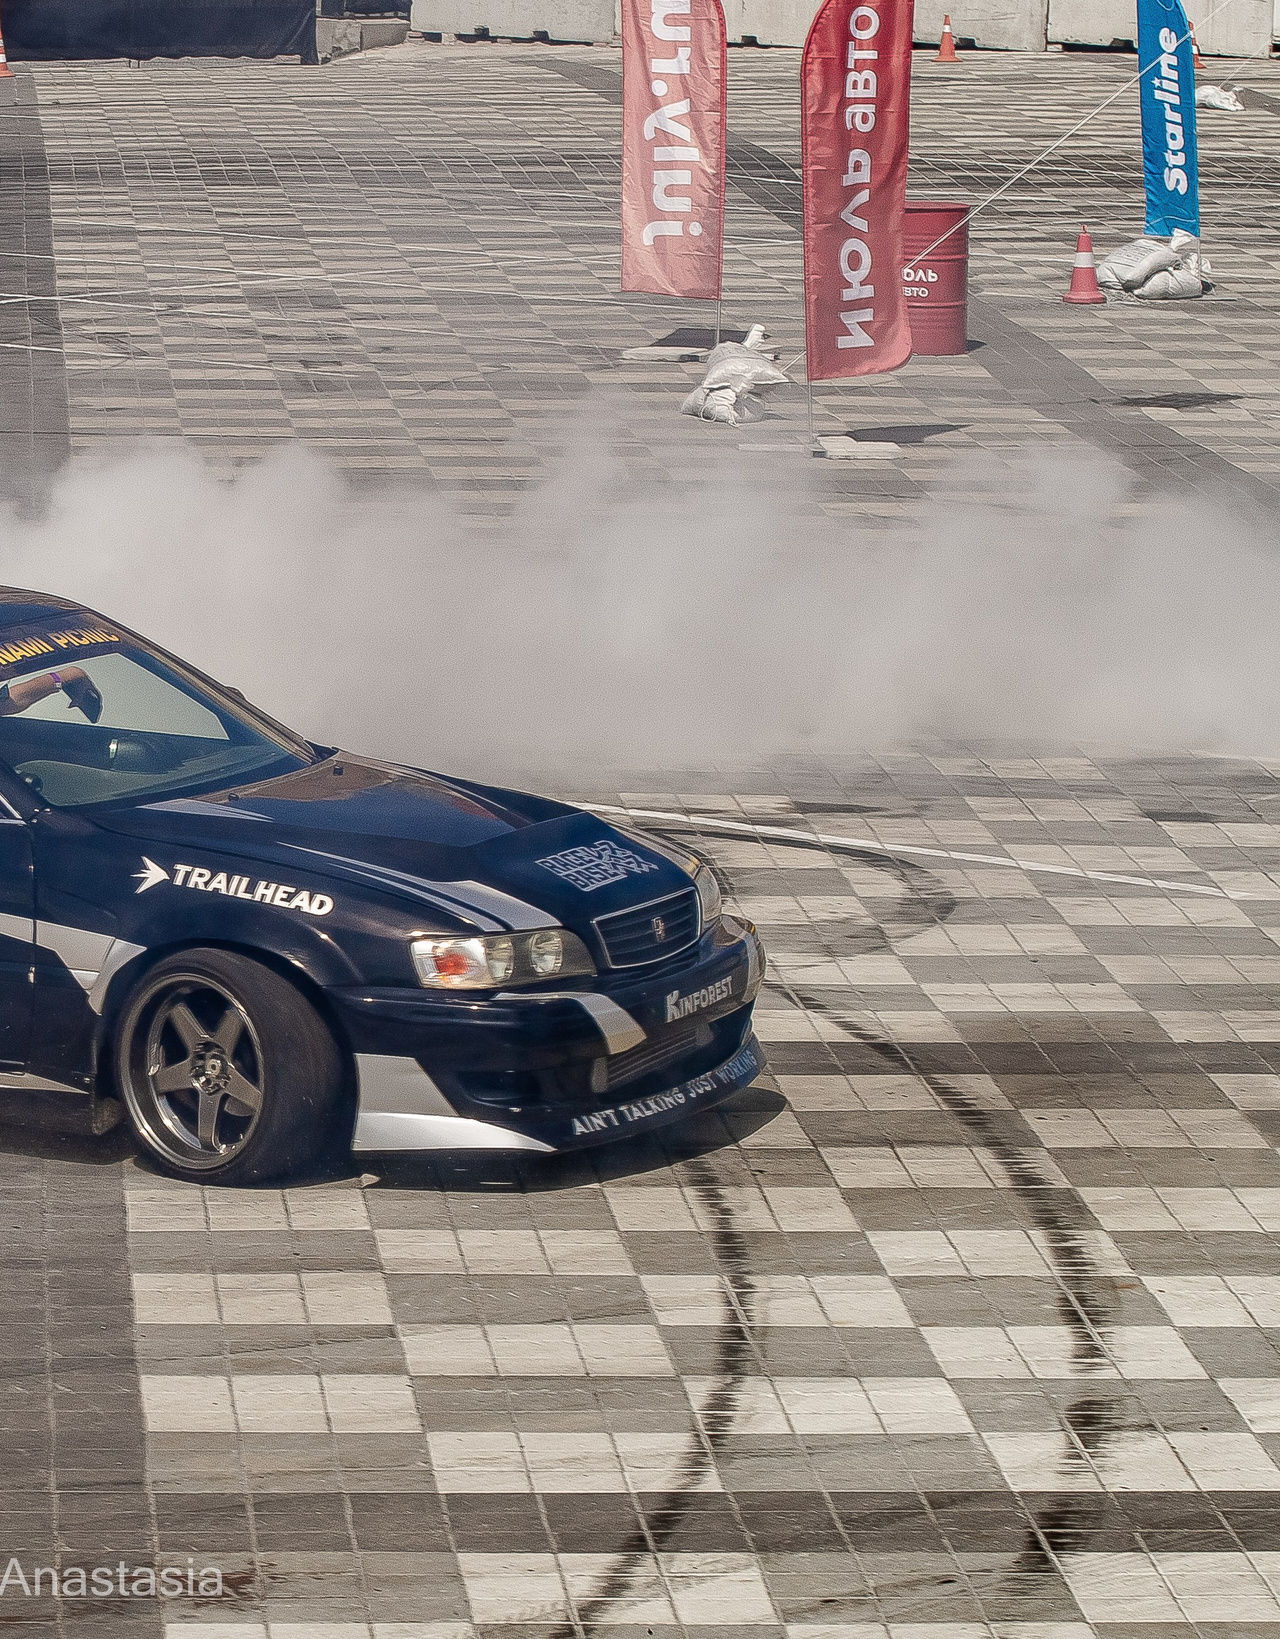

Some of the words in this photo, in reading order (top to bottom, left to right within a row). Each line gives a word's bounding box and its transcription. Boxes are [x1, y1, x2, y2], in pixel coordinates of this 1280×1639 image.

[47, 628, 120, 649] PICNIC
[173, 863, 335, 916] TRAILHEAD
[571, 1109, 620, 1135] AIN'T
[618, 1087, 686, 1121] TALKING
[687, 1074, 718, 1098] JUST
[716, 1049, 758, 1084] WORKING
